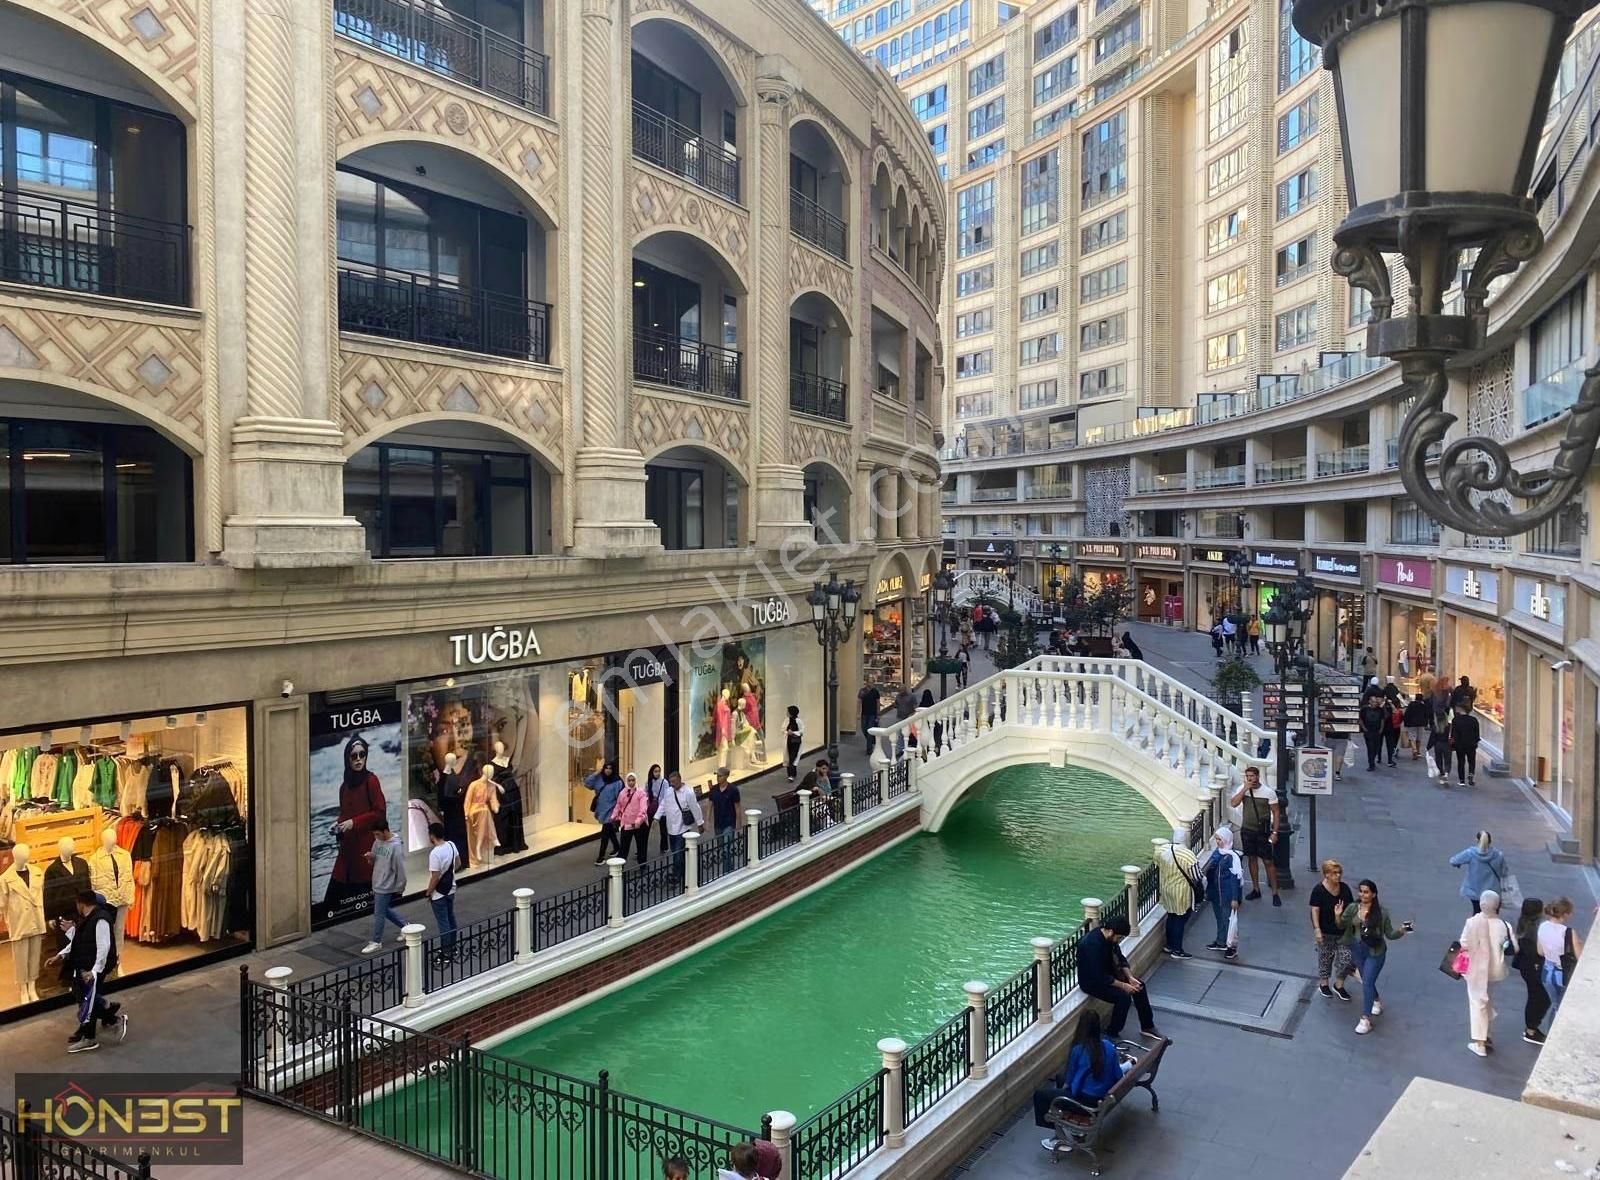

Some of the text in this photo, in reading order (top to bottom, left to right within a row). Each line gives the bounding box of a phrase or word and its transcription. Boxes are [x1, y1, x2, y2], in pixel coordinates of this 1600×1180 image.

[1206, 551, 1223, 561] AKER
[752, 597, 790, 625] TUĞBA
[449, 626, 541, 666] TUĞBA
[632, 659, 668, 680] TUĞBA
[330, 708, 382, 729] TUĞBA
